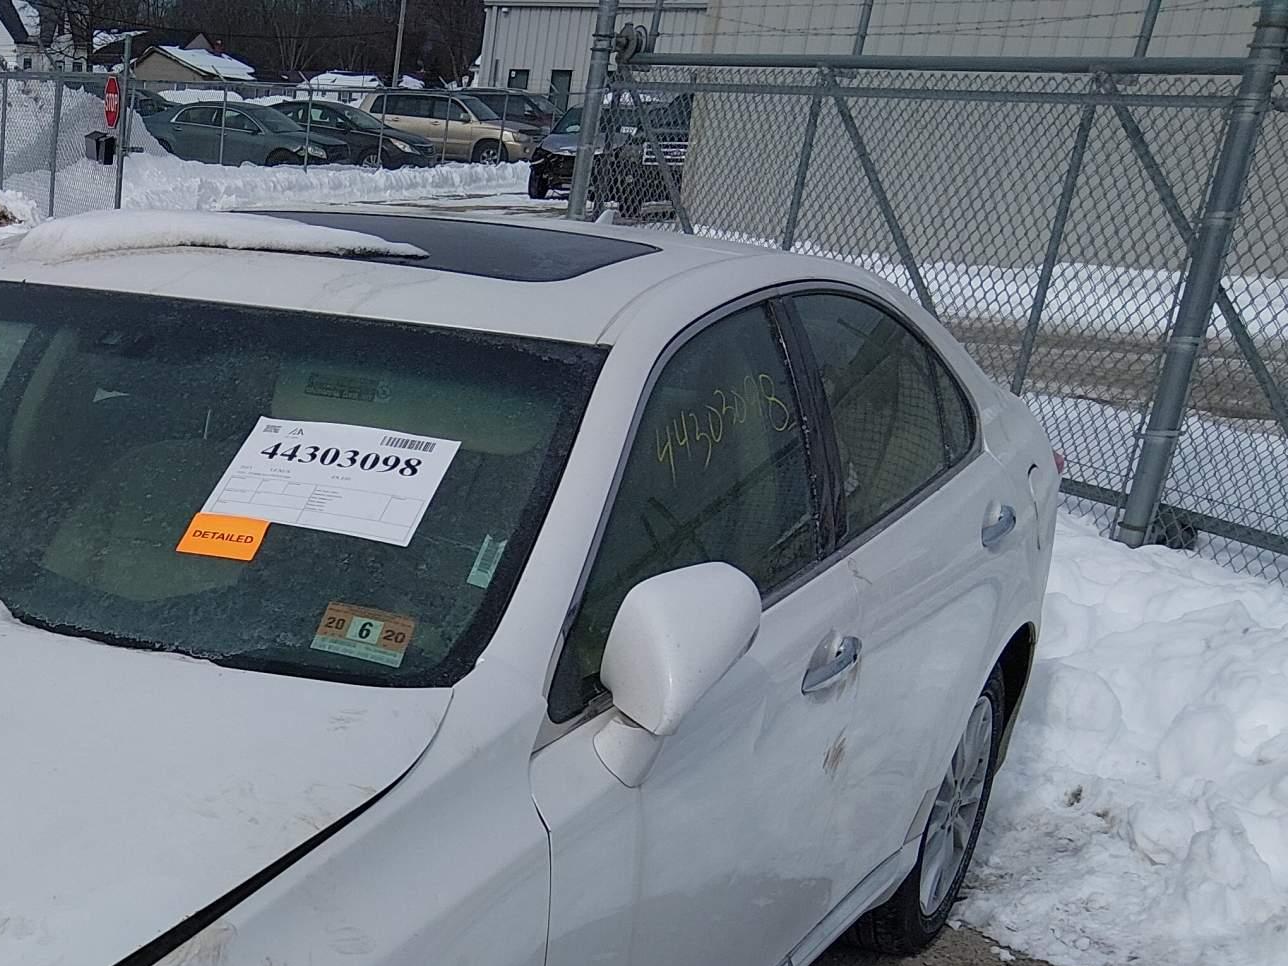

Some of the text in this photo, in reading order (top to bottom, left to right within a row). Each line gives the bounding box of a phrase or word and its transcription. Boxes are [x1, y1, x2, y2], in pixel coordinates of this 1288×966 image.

[105, 93, 118, 112] STOP
[260, 441, 423, 477] 44303098
[192, 529, 254, 544] DETAILED
[326, 616, 406, 644] 20 6 20
